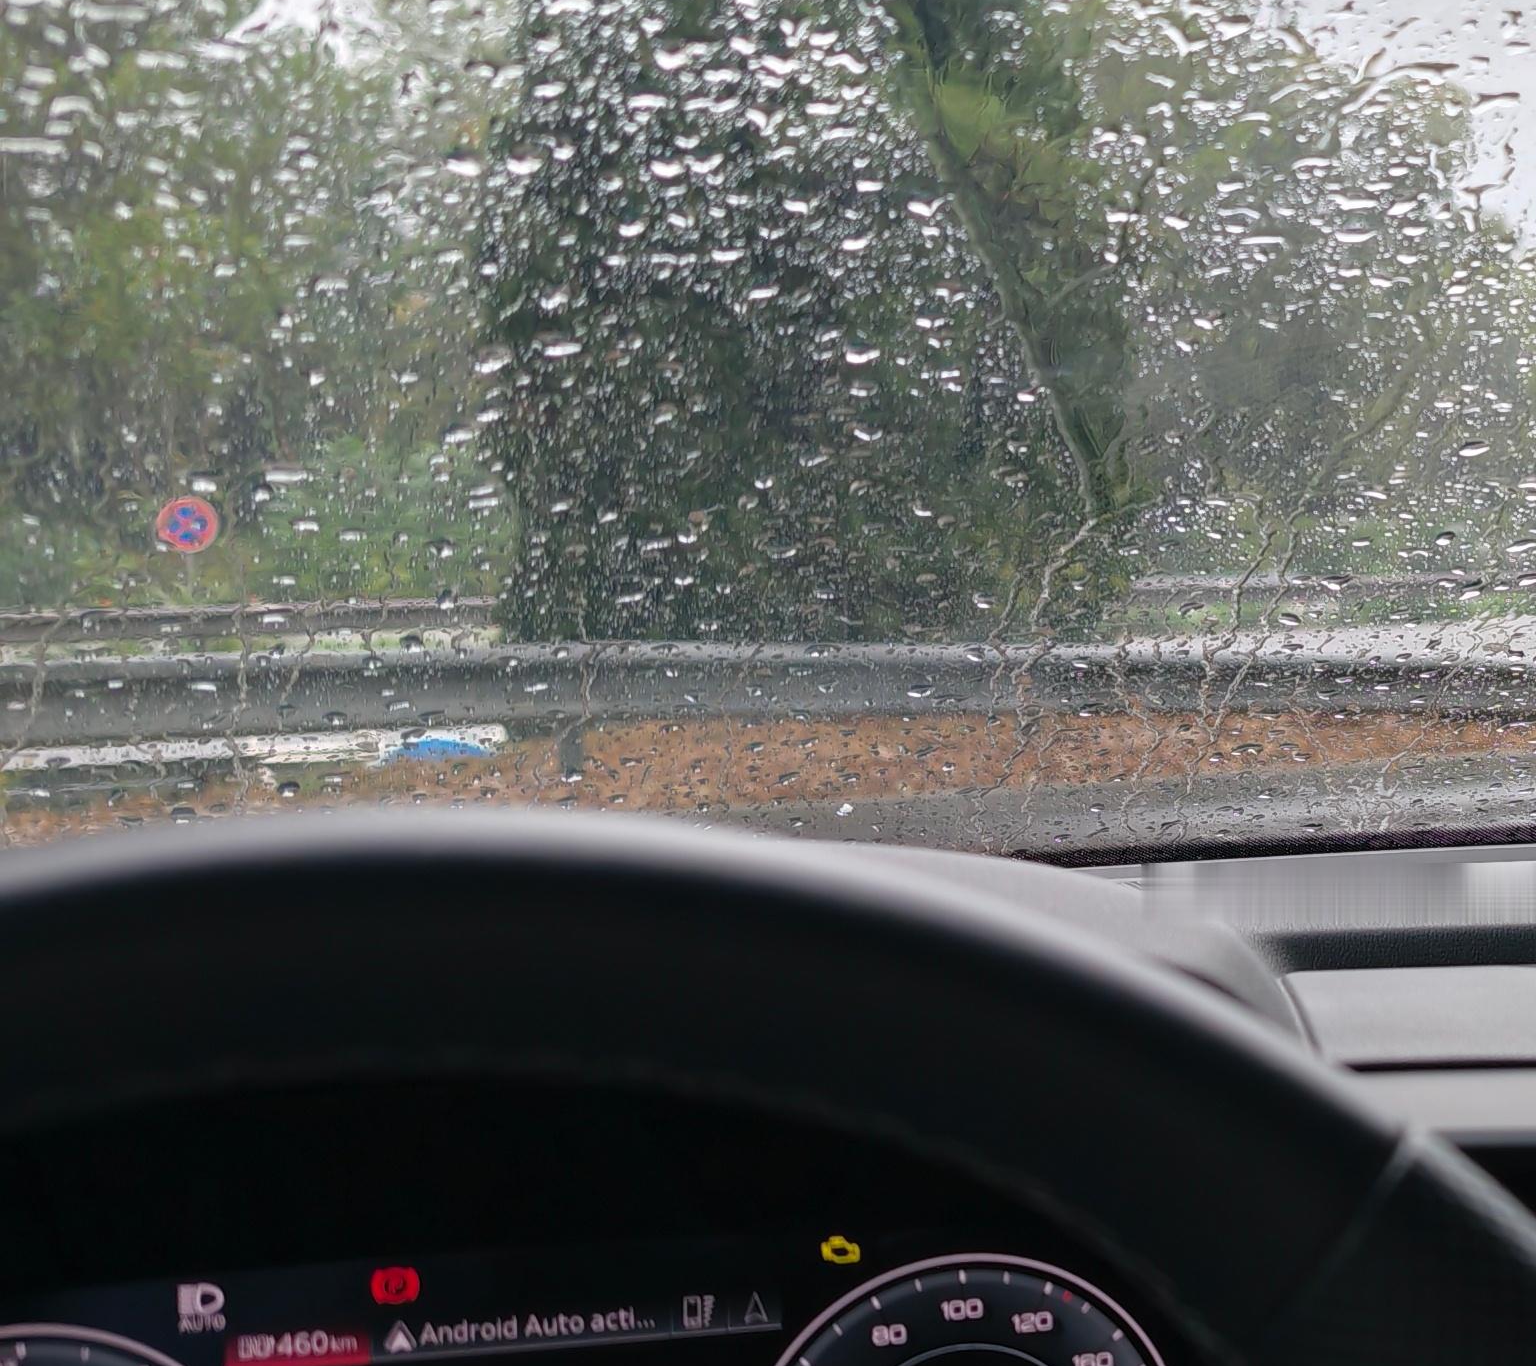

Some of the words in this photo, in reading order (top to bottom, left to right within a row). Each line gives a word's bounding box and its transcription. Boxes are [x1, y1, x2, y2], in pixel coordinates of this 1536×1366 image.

[940, 1298, 984, 1321] 100
[179, 1314, 227, 1334] AUTO
[420, 1315, 517, 1346] Android
[524, 1312, 584, 1337] Auto
[1011, 1310, 1054, 1333] 120
[871, 1324, 907, 1345] 80
